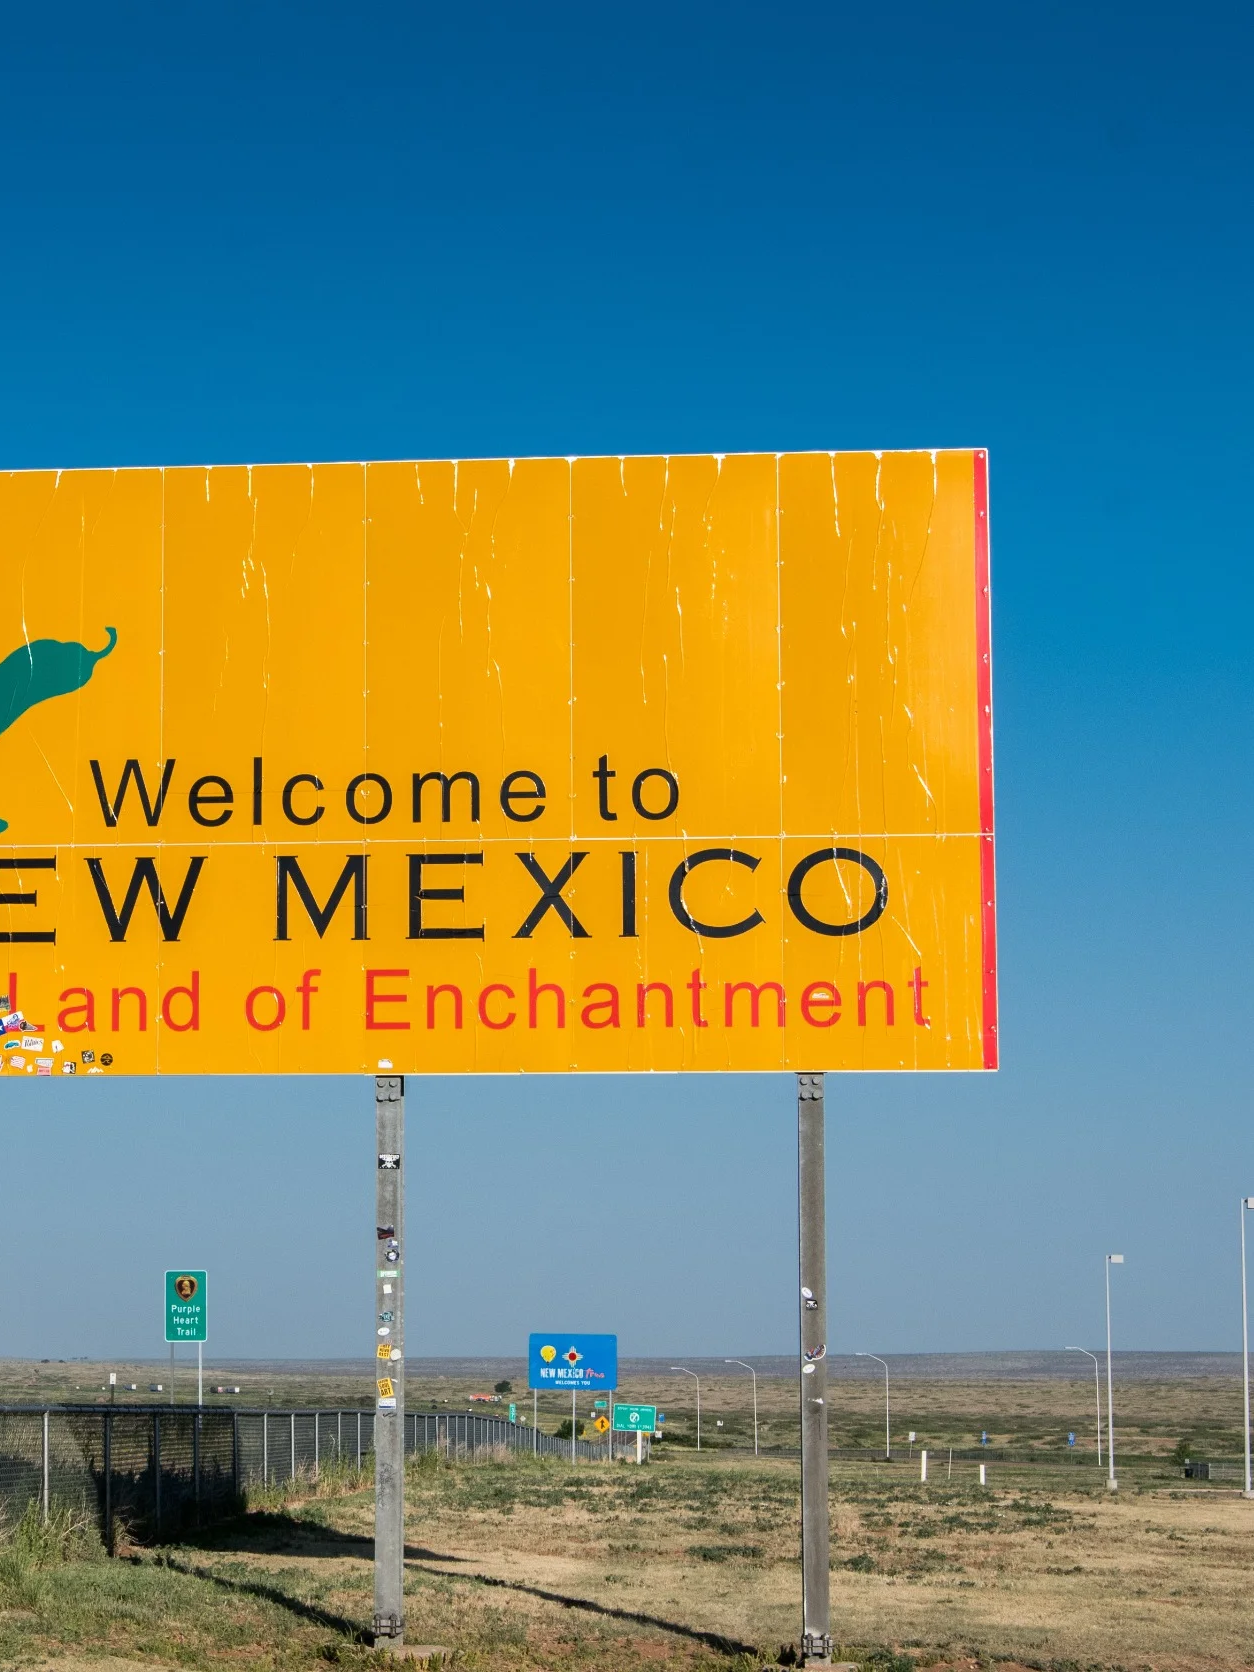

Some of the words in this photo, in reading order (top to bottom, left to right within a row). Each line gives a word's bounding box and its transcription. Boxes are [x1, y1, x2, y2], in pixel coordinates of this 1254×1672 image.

[89, 757, 546, 829] Welcome
[593, 754, 679, 822] to
[273, 847, 890, 943] MEXICO
[8, 970, 200, 1033] Land
[245, 968, 322, 1031] of
[365, 965, 930, 1031] Enchantment
[171, 1304, 201, 1315] Purple
[173, 1316, 199, 1325] Heart
[176, 1327, 196, 1336] Trail
[540, 1368, 556, 1378] NEW
[557, 1368, 584, 1379] MEXICO
